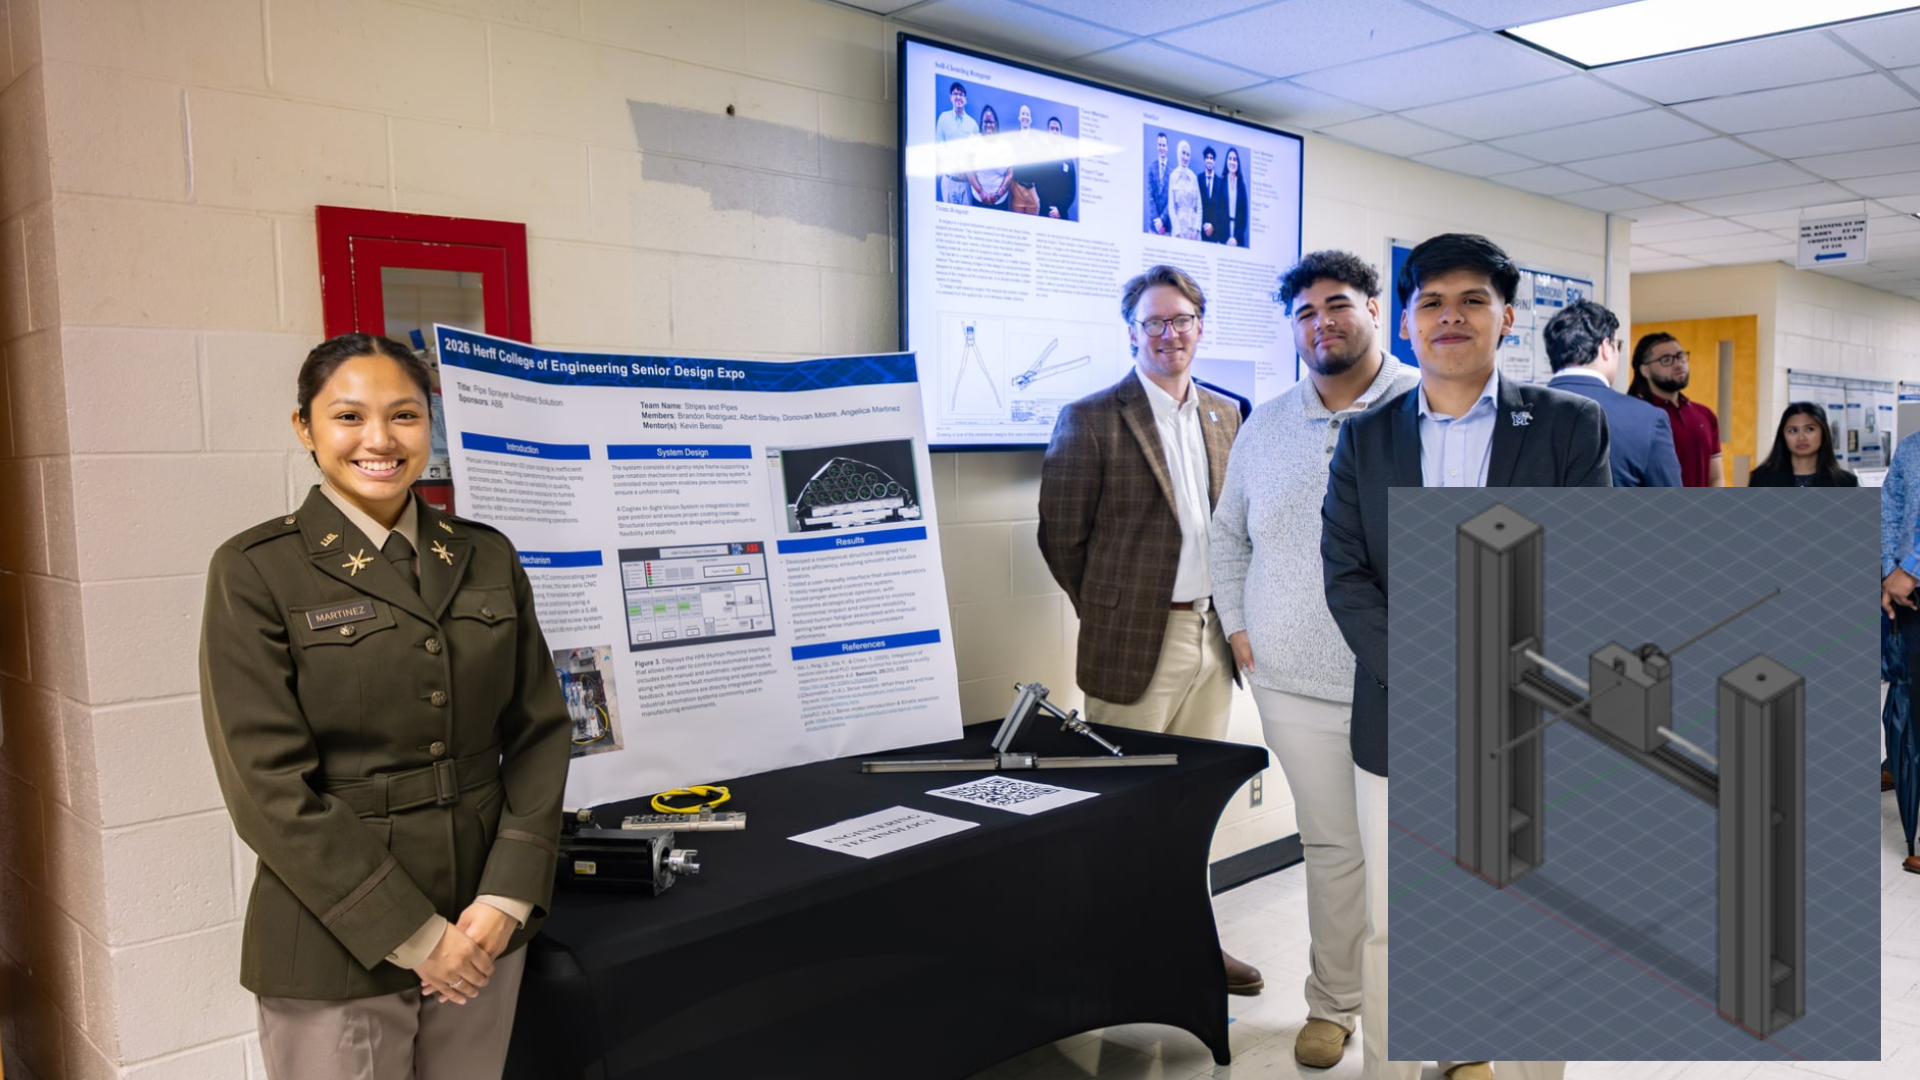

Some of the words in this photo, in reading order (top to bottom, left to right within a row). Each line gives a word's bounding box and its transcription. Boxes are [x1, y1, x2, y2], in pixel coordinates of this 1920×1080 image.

[445, 338, 470, 354] 2026
[473, 345, 497, 361] Herff
[498, 350, 535, 369] College
[537, 359, 548, 370] of
[551, 360, 628, 377] Engineering
[631, 364, 670, 376] Senior
[674, 365, 714, 379] Design
[718, 367, 745, 380] Expo
[685, 402, 706, 411] Stripes
[783, 412, 813, 420] Donovan
[506, 442, 539, 454] Introduction
[657, 448, 683, 458] System
[685, 448, 709, 458] Design
[836, 536, 865, 546] Results
[315, 606, 366, 623] MARTINEZ
[842, 640, 885, 651] References
[635, 659, 653, 668] Figure
[824, 814, 921, 844] ENGINEERING
[839, 818, 936, 848] TECHNOLOGY
